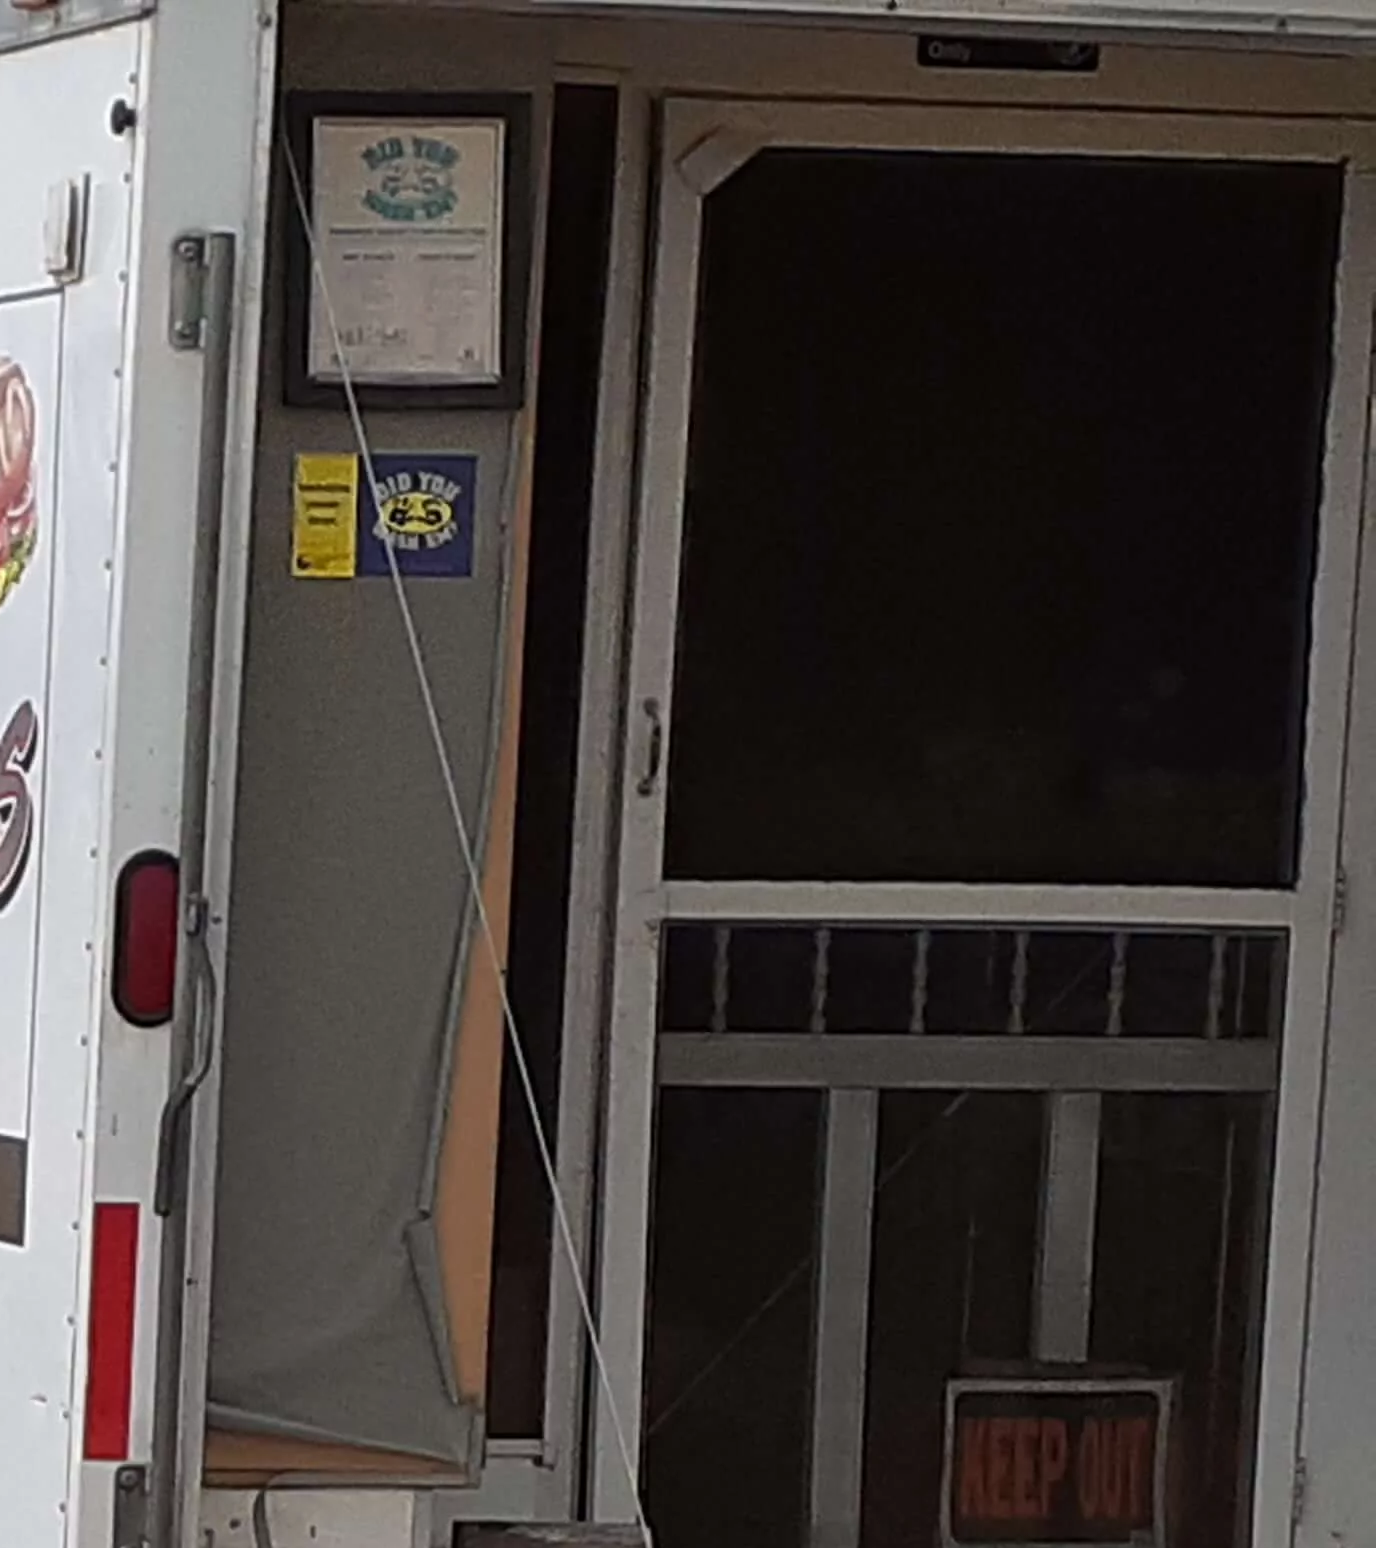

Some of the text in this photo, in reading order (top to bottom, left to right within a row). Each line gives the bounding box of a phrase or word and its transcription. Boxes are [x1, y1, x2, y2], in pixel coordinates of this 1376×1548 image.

[375, 471, 461, 502] DID YOU
[959, 1414, 1149, 1520] KEEP OUT
